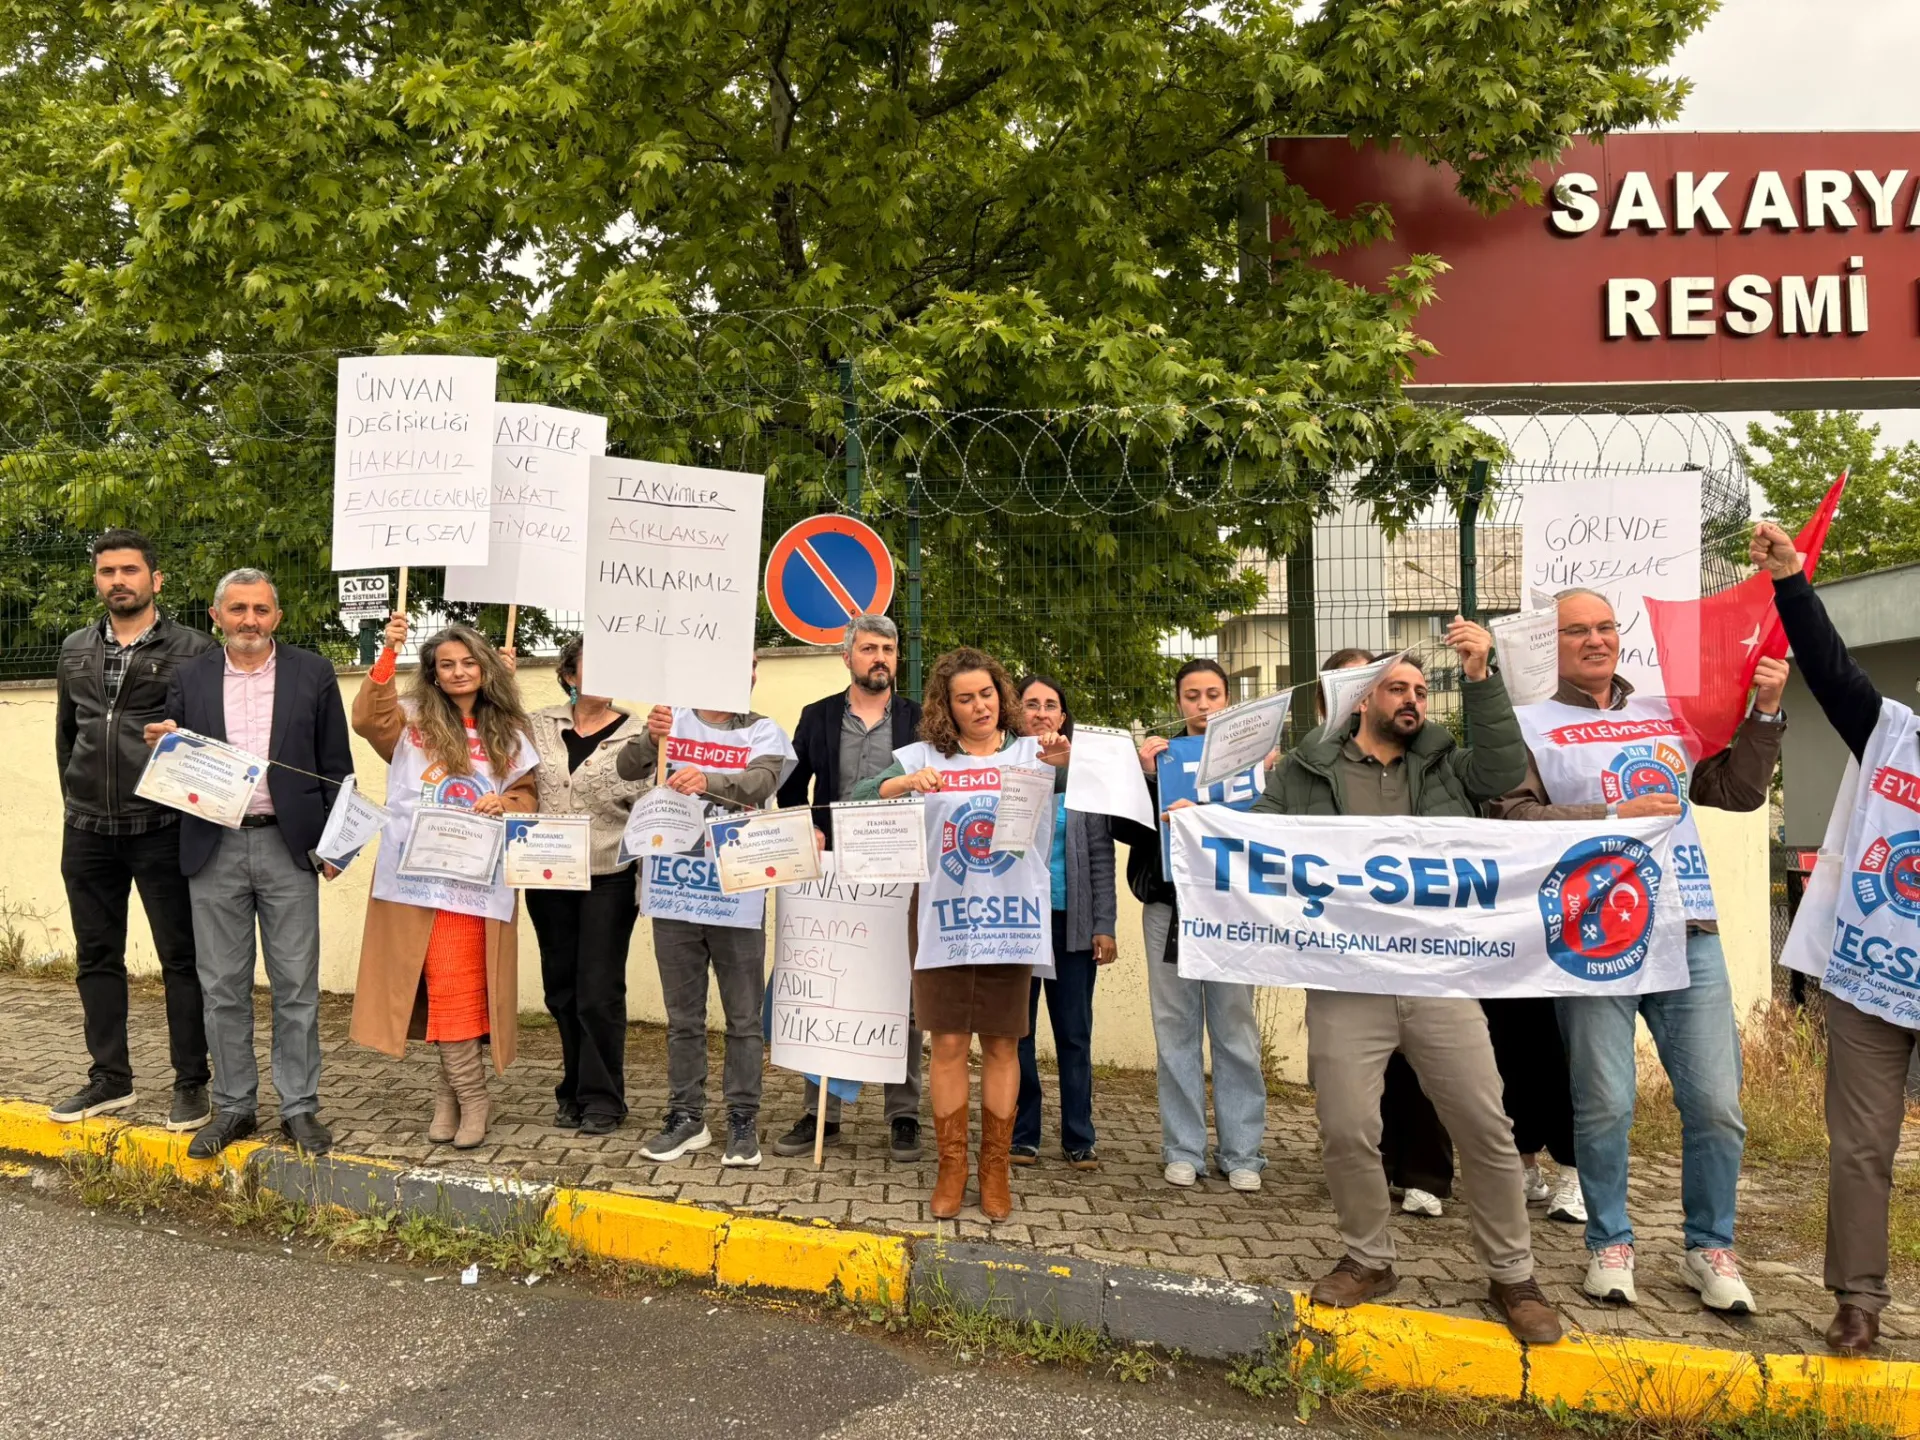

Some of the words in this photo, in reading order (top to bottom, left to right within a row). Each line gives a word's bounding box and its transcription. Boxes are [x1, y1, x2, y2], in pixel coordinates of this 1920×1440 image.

[1550, 168, 1920, 234] SAKARY
[1606, 256, 1869, 338] RESMİ
[356, 371, 453, 402] ÜNVAN
[347, 409, 470, 437] DEĞİŞİKLİĞİ
[495, 414, 588, 450] ARİYER
[349, 449, 474, 477] HAKKIMIZ
[506, 455, 539, 474] VE
[494, 484, 560, 506] YAKAT
[606, 476, 730, 509] TAKVİMLER
[609, 516, 730, 548] AÇIKLANSIN
[1545, 513, 1669, 551] GÖREVDE
[599, 560, 740, 593] HAKLARIMIZ
[1533, 555, 1669, 586] YÜKSELME
[1660, 748, 1682, 769] YHS
[1604, 776, 1619, 798] SHS
[943, 826, 953, 848] SHS
[1864, 843, 1888, 870] SHS
[1201, 835, 1500, 918] TEÇ-SEN
[1857, 878, 1877, 904] GİH
[782, 913, 869, 940] ATAMA
[932, 896, 1041, 932] TEÇ-SEN
[1182, 918, 1222, 939] TÜM
[1226, 921, 1291, 945] EĞİTİM
[1294, 930, 1417, 955] ÇALIŞANLARI
[1420, 936, 1516, 958] SENDİKASI
[778, 972, 823, 999] ADİL
